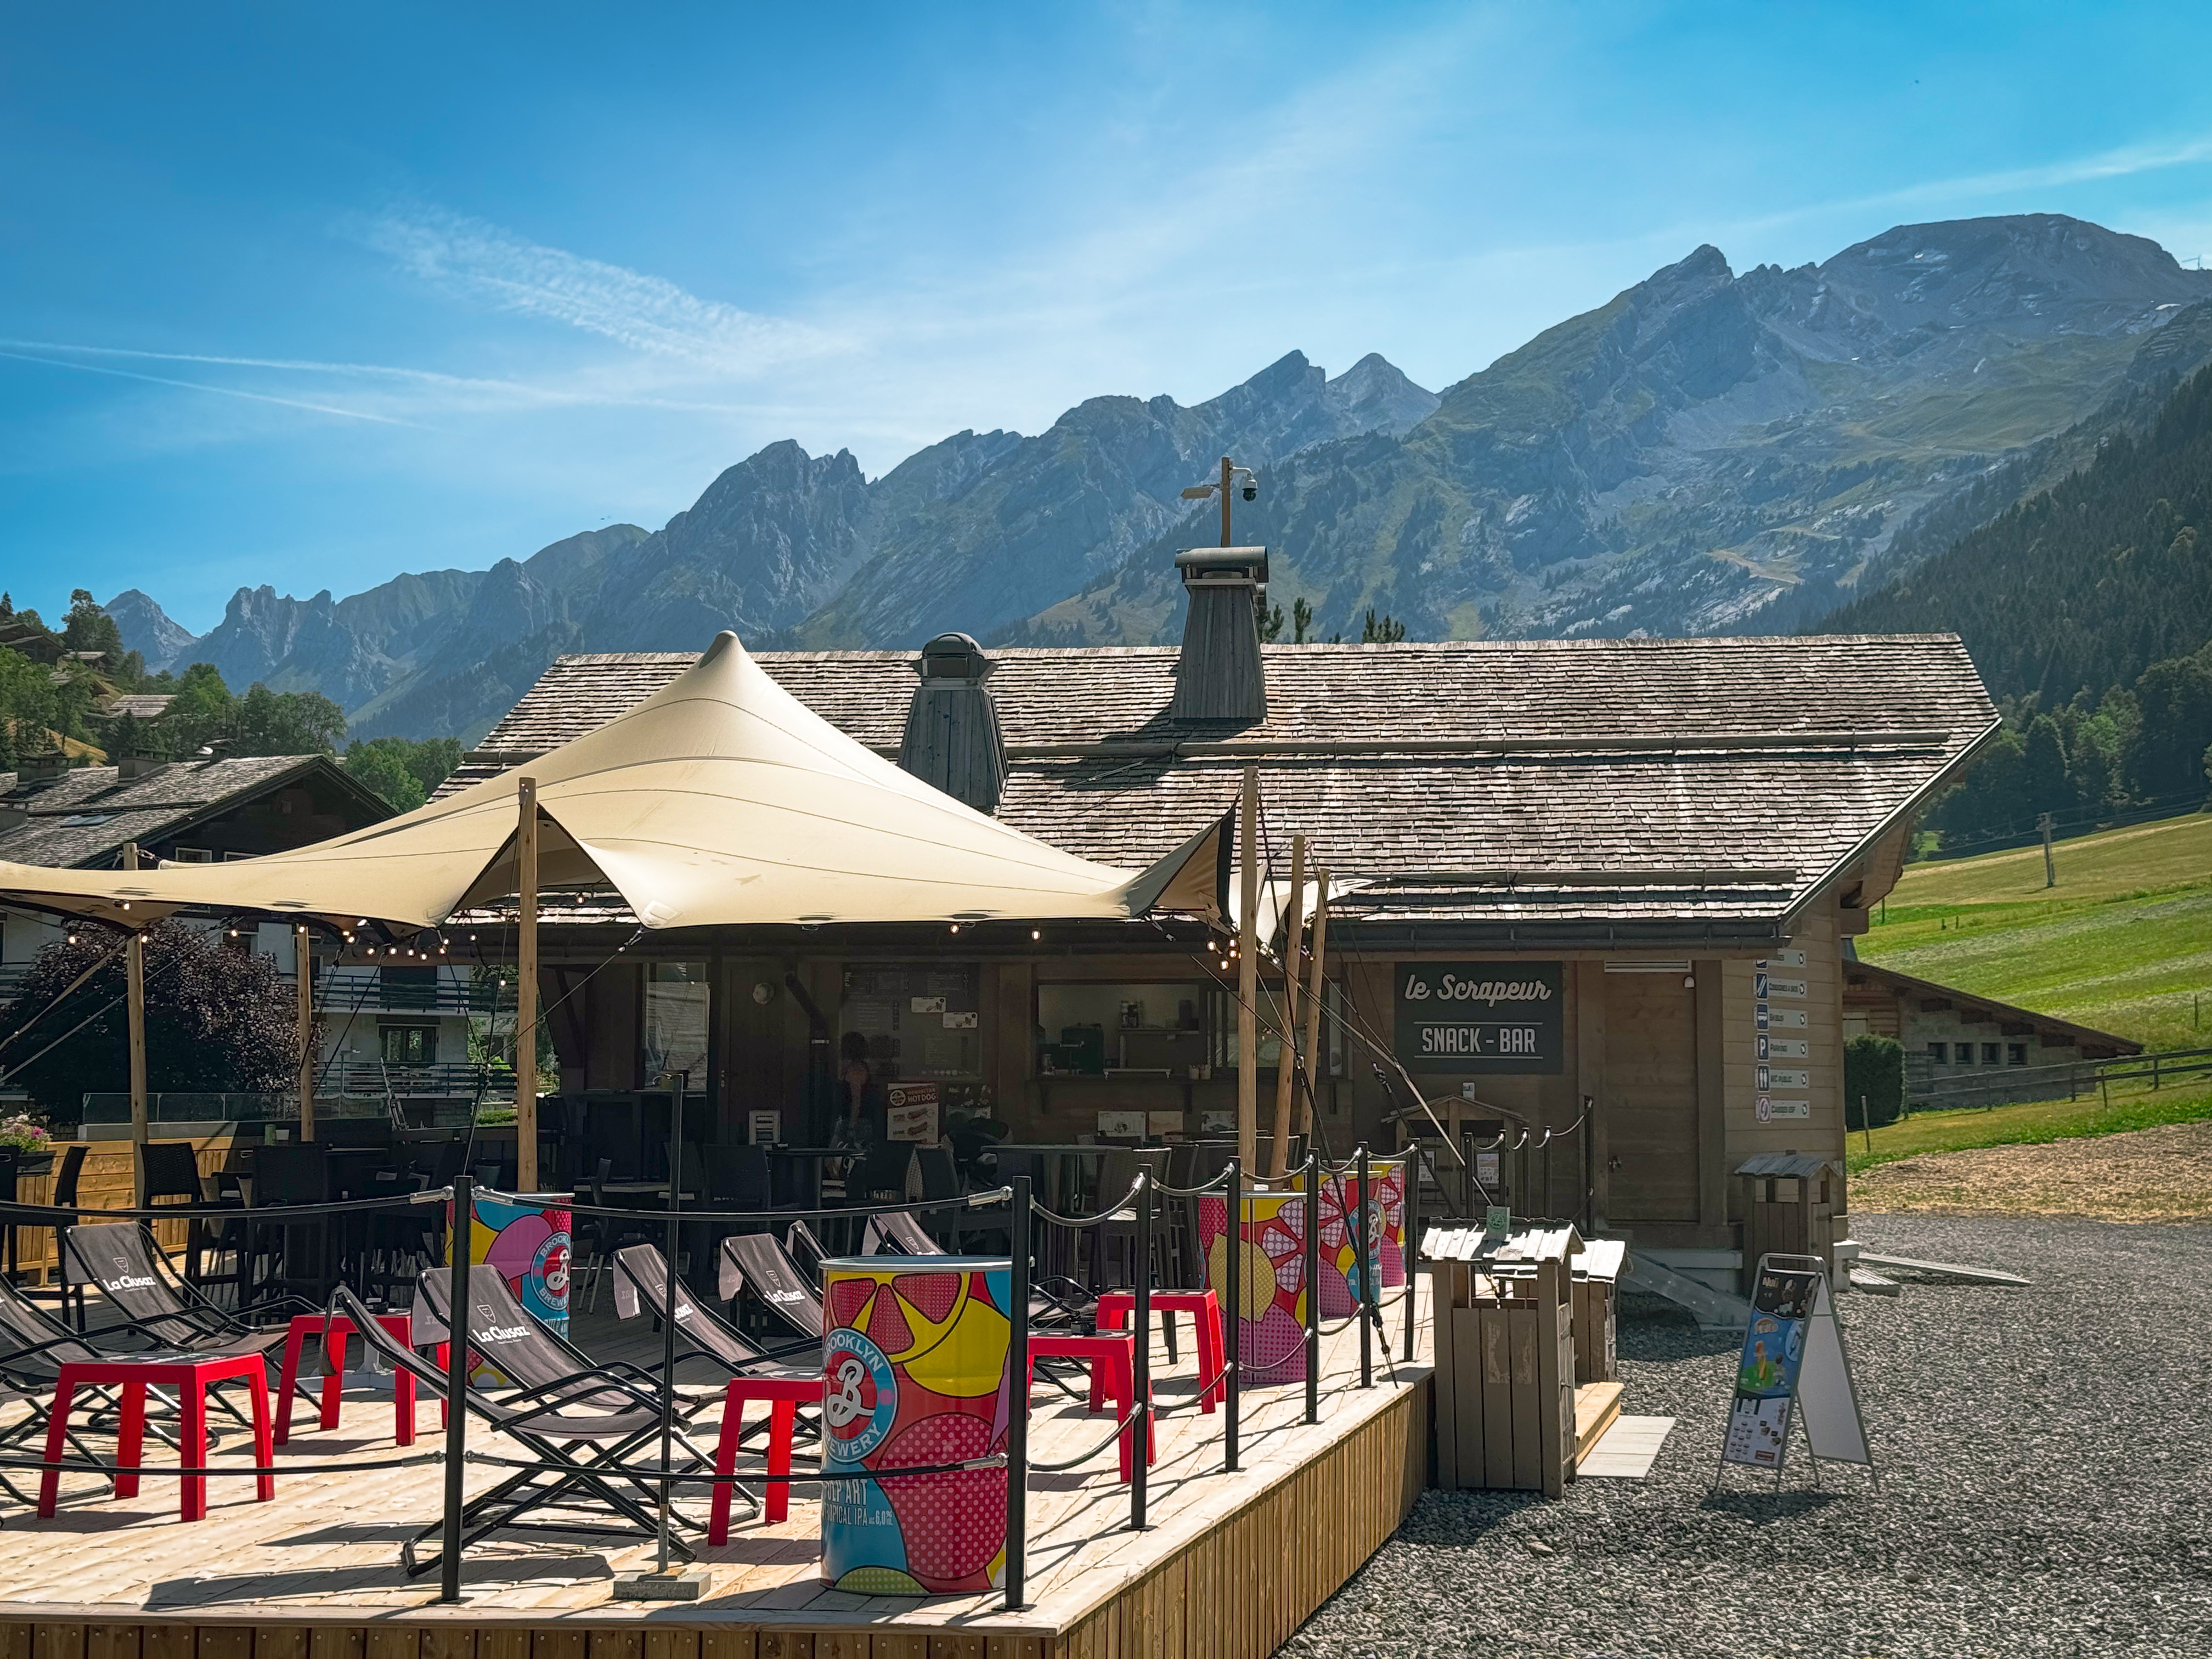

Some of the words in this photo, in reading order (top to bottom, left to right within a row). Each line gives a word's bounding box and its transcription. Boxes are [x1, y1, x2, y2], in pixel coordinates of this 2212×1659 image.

[1404, 974, 1431, 1000] le
[1437, 973, 1552, 1008] Scrapeur
[1422, 1028, 1481, 1053] SNACK
[1499, 1028, 1536, 1053] BAR
[540, 1235, 570, 1258] BROOKL
[102, 1279, 122, 1291] La
[120, 1275, 156, 1288] Clusaz
[539, 1288, 569, 1307] BREWE
[765, 1290, 783, 1302] La
[777, 1289, 806, 1302] Clusaz
[472, 1329, 494, 1342] La
[489, 1325, 531, 1340] Clusaz
[845, 1479, 868, 1506] ART
[824, 1502, 852, 1525] TROPICAL
[854, 1508, 868, 1527] IPA
